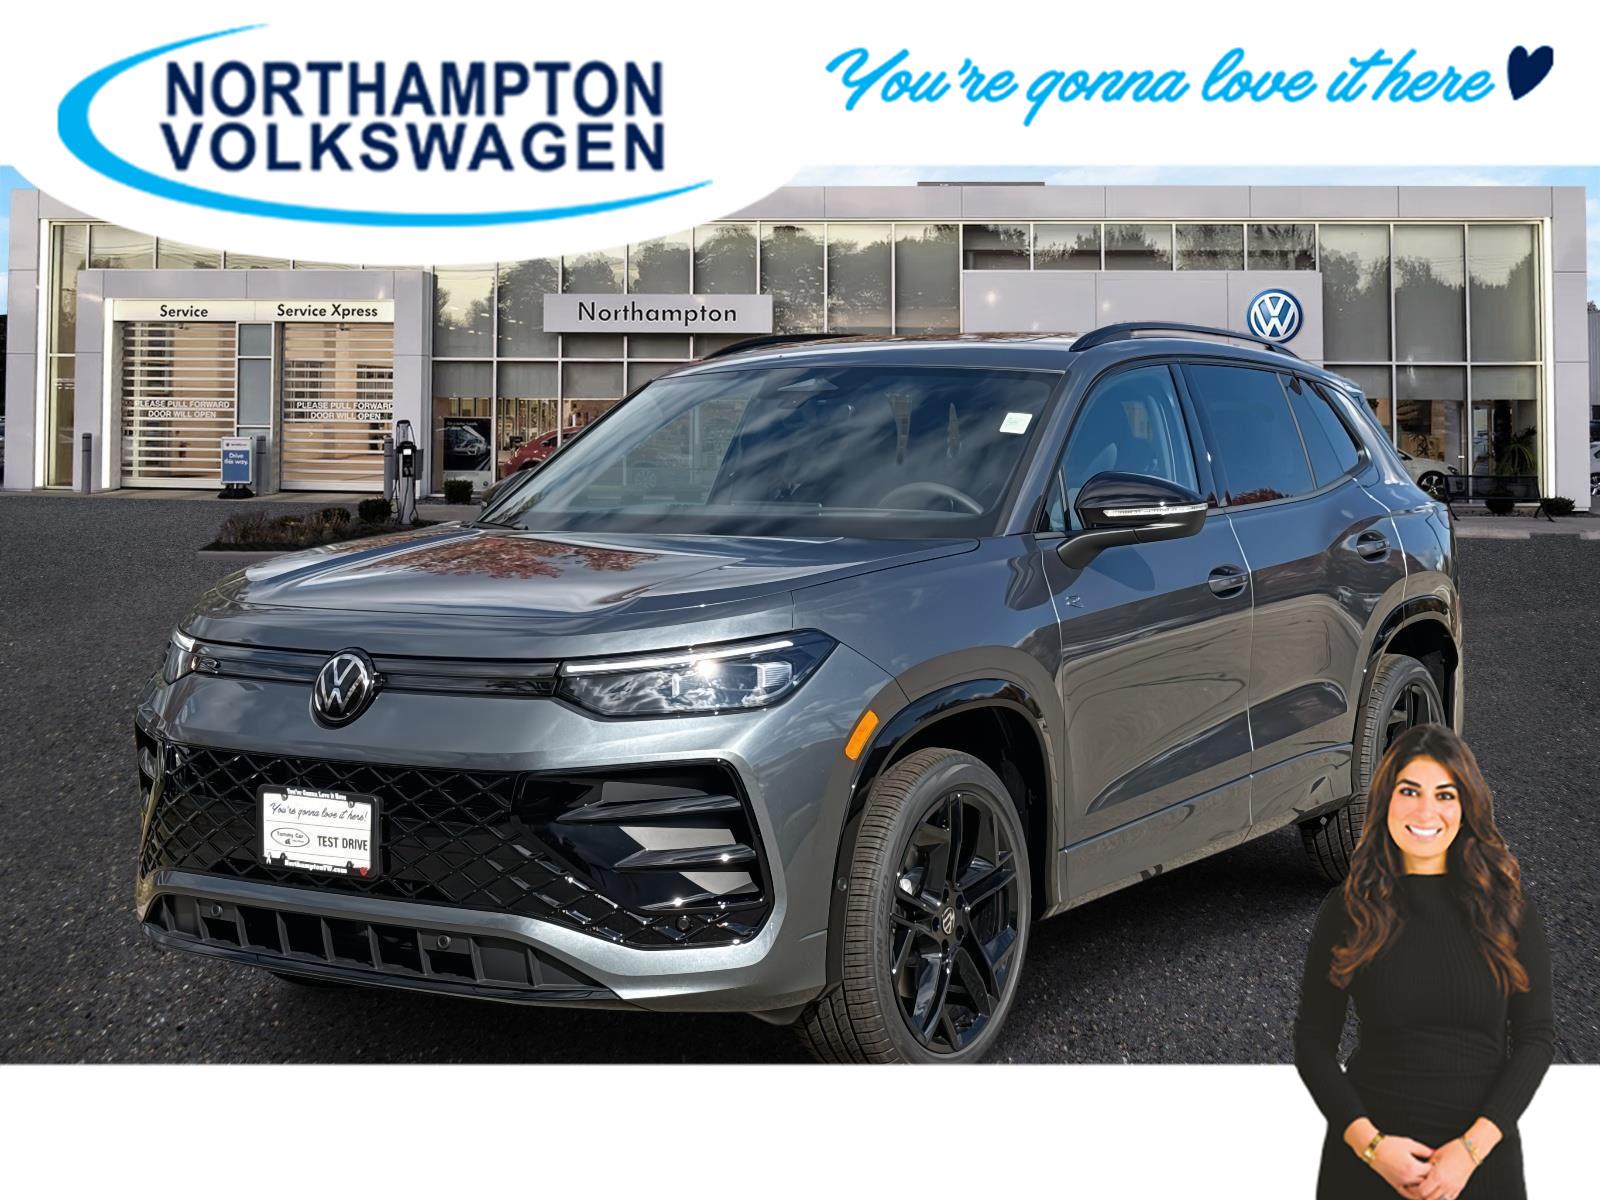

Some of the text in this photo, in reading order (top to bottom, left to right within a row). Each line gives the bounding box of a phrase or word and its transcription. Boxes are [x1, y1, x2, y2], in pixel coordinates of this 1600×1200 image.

[159, 304, 208, 319] Service
[276, 303, 378, 320] Service Xpress
[577, 301, 737, 327] Northampton
[135, 400, 230, 409] PLEASE PULL FORWARD
[296, 401, 394, 410] PLEASE PULL FORWARD
[148, 410, 171, 418] DOOR
[336, 412, 356, 420] WILL
[358, 412, 381, 420] OPEN
[270, 802, 368, 822] You're gonna love it here!
[317, 835, 338, 848] TEST
[342, 838, 368, 852] DRIVE
